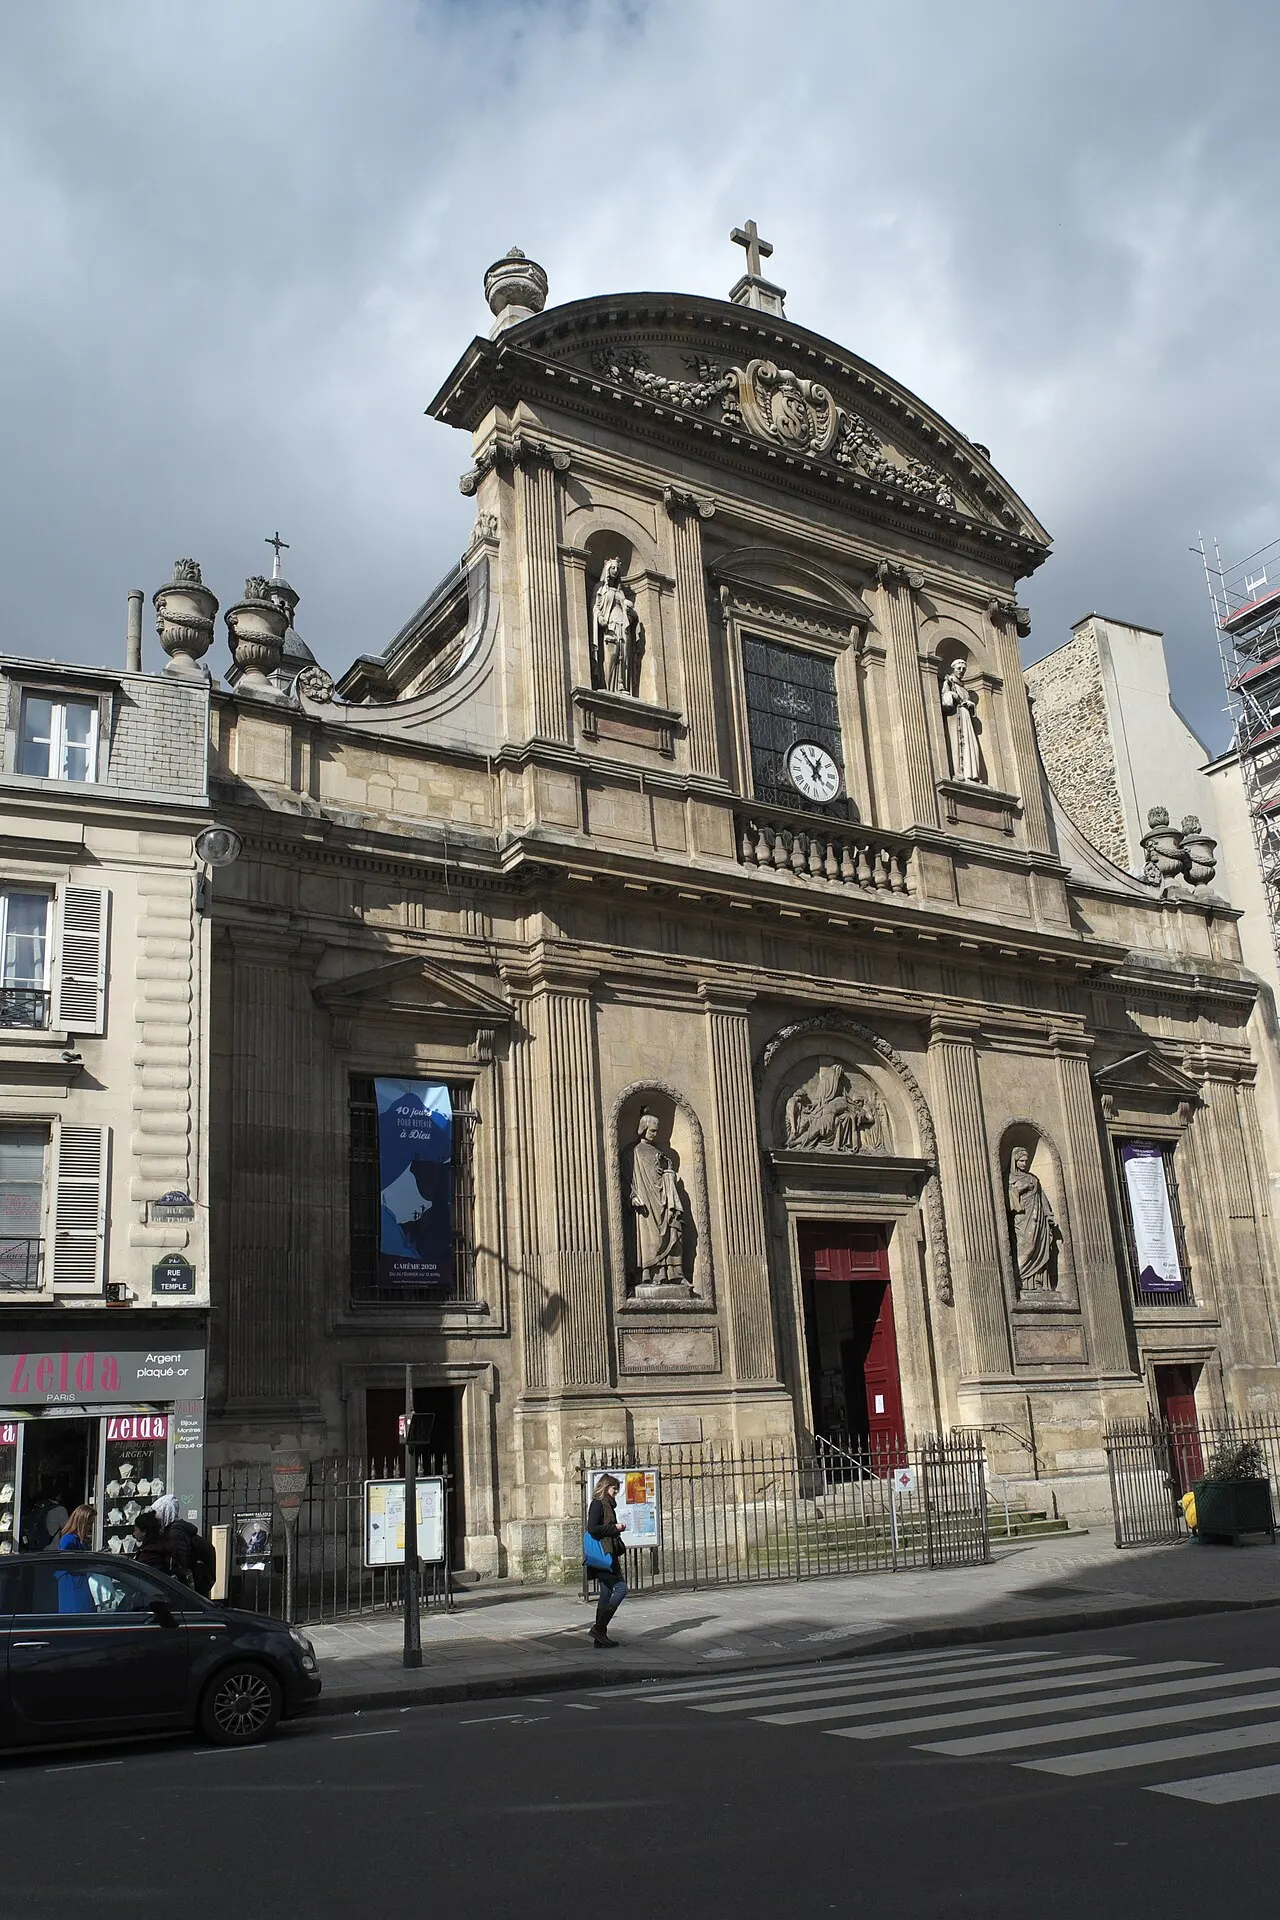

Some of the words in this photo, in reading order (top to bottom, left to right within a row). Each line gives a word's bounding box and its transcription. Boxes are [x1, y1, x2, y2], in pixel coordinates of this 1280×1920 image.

[396, 1106, 409, 1114] 40
[410, 1107, 432, 1117] jours
[412, 1119, 432, 1128] REVENIR
[400, 1129, 407, 1138] à
[408, 1130, 431, 1140] Dieu
[145, 1354, 181, 1364] Argent
[9, 1339, 122, 1392] Zelda
[107, 1416, 164, 1439] Zelda
